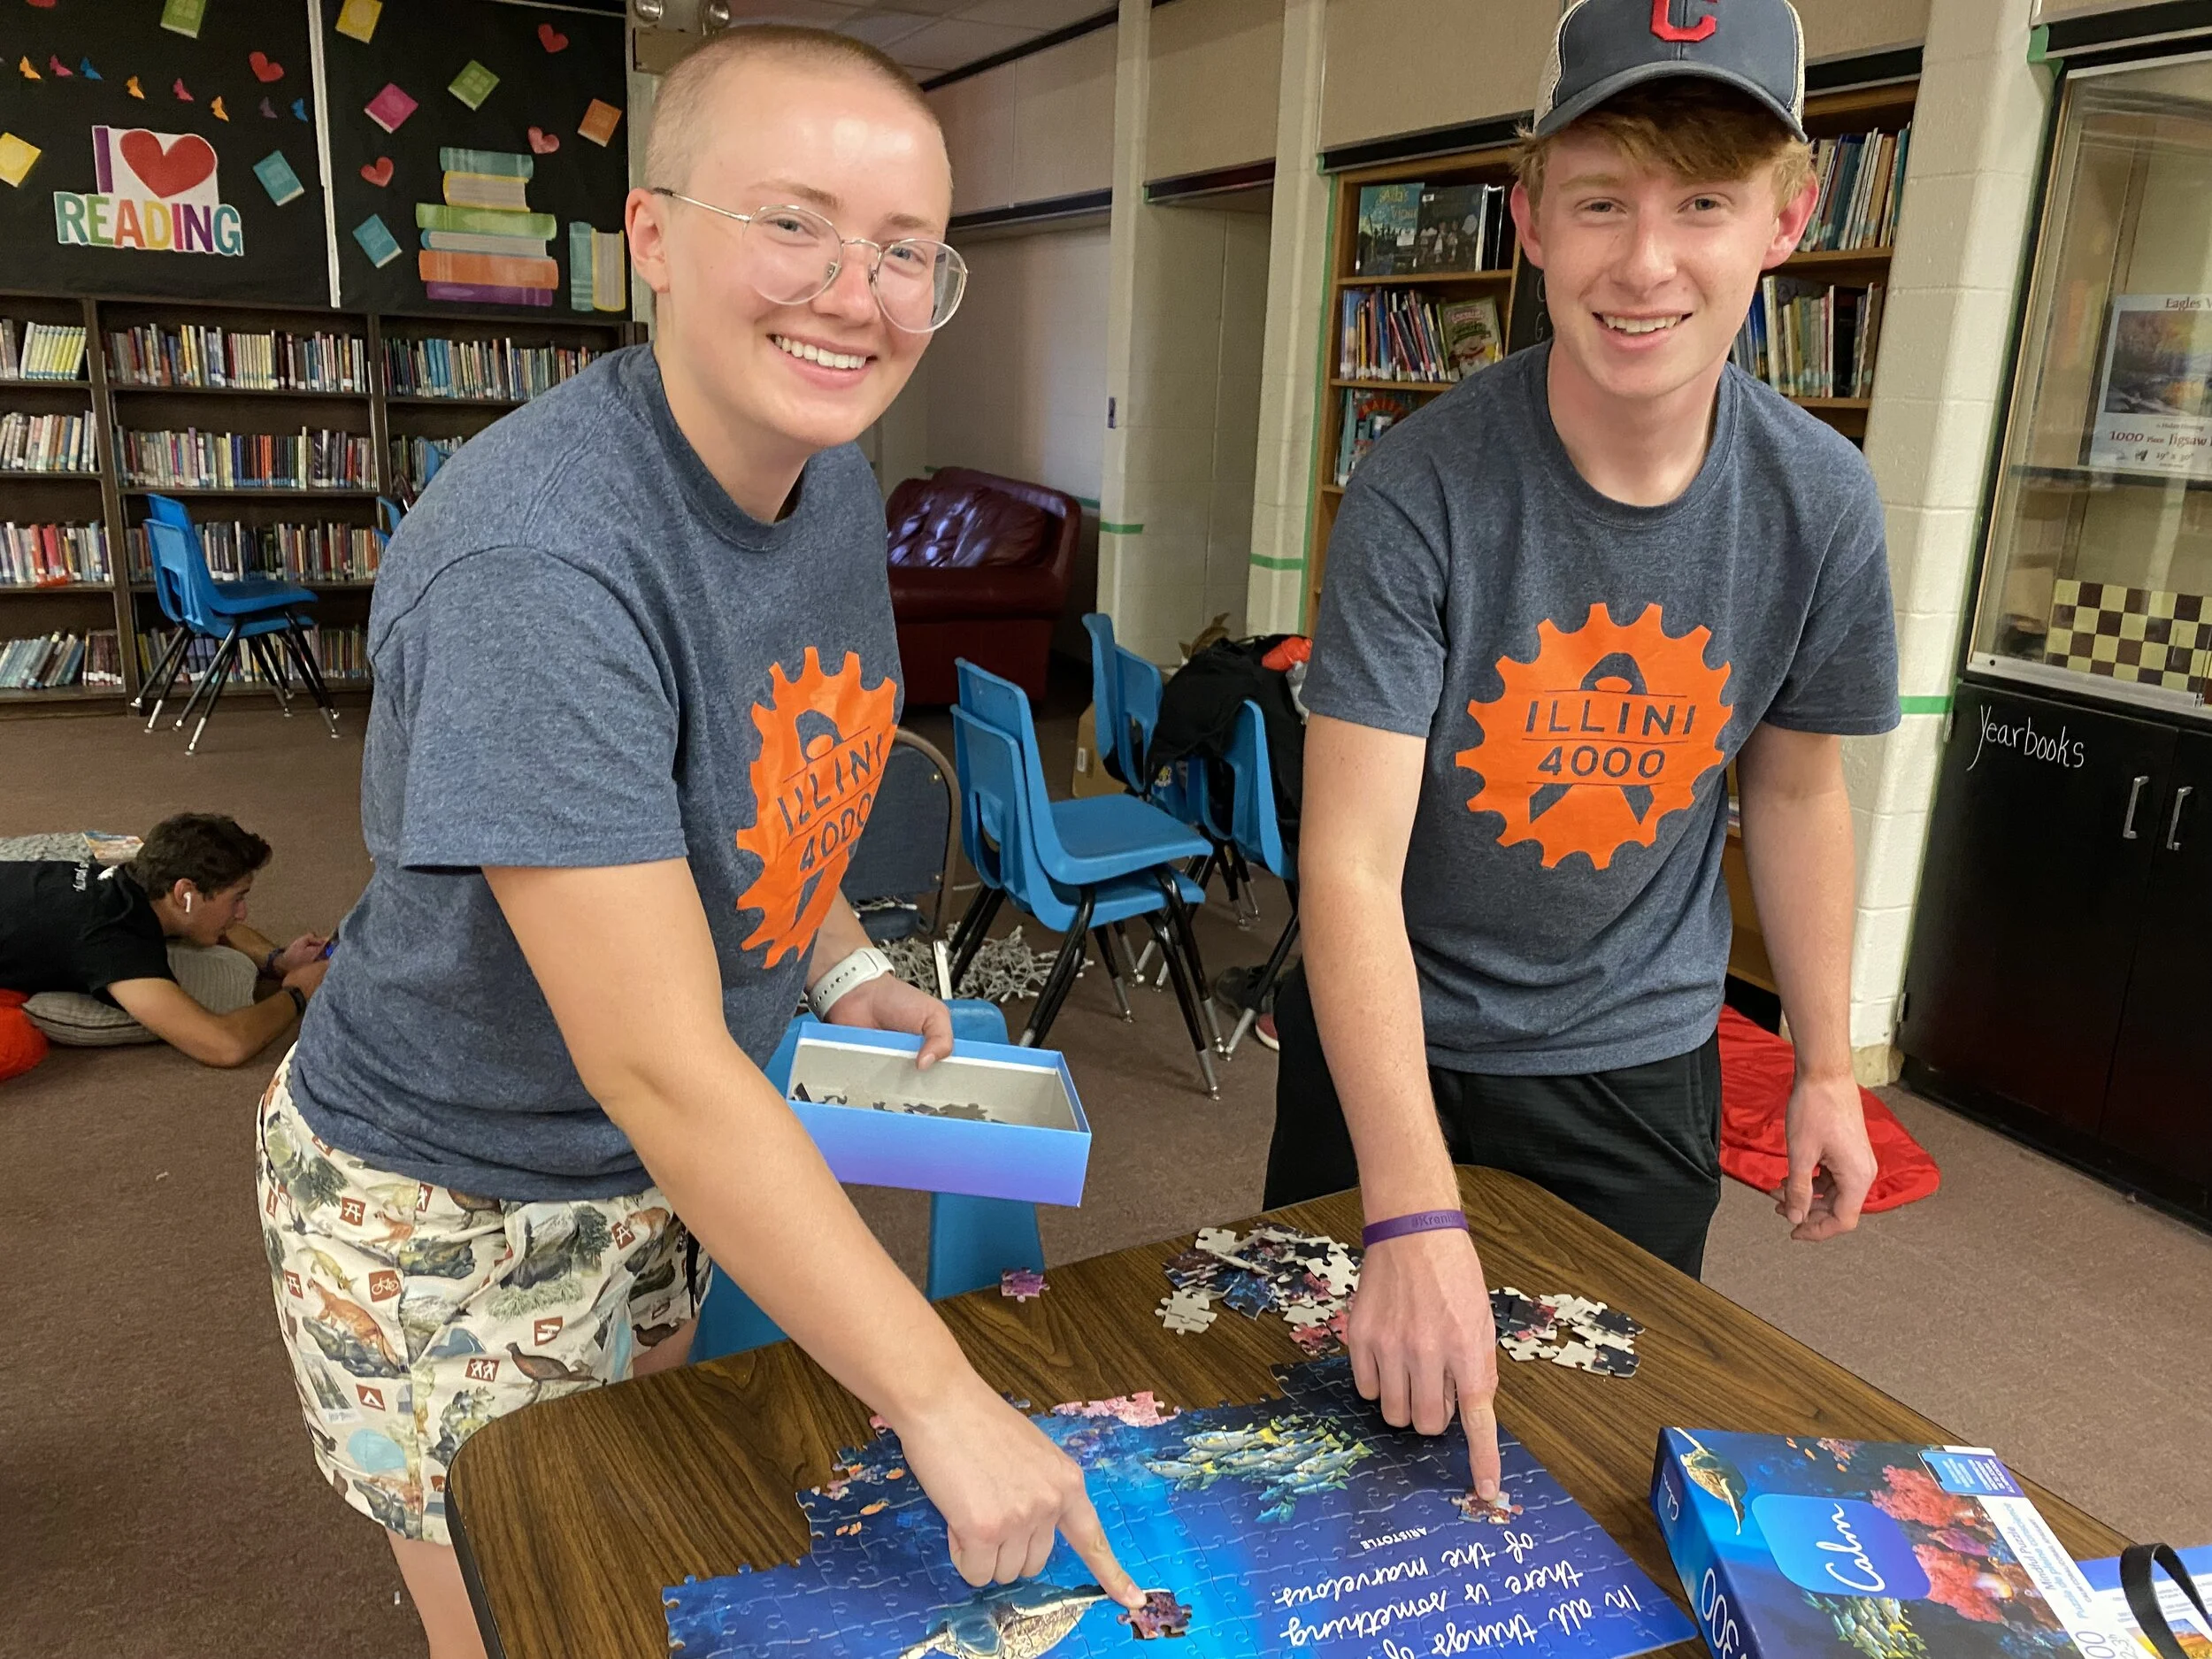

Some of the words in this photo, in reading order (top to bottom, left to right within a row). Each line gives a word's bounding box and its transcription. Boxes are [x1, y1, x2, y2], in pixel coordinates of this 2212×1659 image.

[1650, 0, 1717, 42] C
[93, 125, 114, 194] I
[54, 191, 243, 255] READING
[2166, 296, 2201, 311] Eagles
[2109, 430, 2145, 442] 1000
[2169, 433, 2208, 449] Jigsaw
[1525, 699, 1696, 737] ILLINI
[1537, 744, 1665, 780] 4000
[777, 733, 882, 836] ILLINI
[799, 793, 872, 872] 4000
[1359, 1526, 1428, 1550] ARISTOTLE
[1441, 1542, 1496, 1570] the
[1503, 1530, 1534, 1563] of
[1816, 1502, 1886, 1593] Calm
[2006, 1525, 2032, 1555] Puzzle
[1271, 1557, 1429, 1608] marvelous.
[1505, 1560, 1584, 1594] there
[2024, 1555, 2056, 1591] Mindful
[1464, 1583, 1492, 1606] is
[1605, 1585, 1641, 1612] In
[2062, 1589, 2089, 1619] Puzzle
[1279, 1590, 1447, 1647] something
[1548, 1597, 1593, 1636] all
[1431, 1613, 1539, 1657] things
[2076, 1631, 2116, 1659] 00
